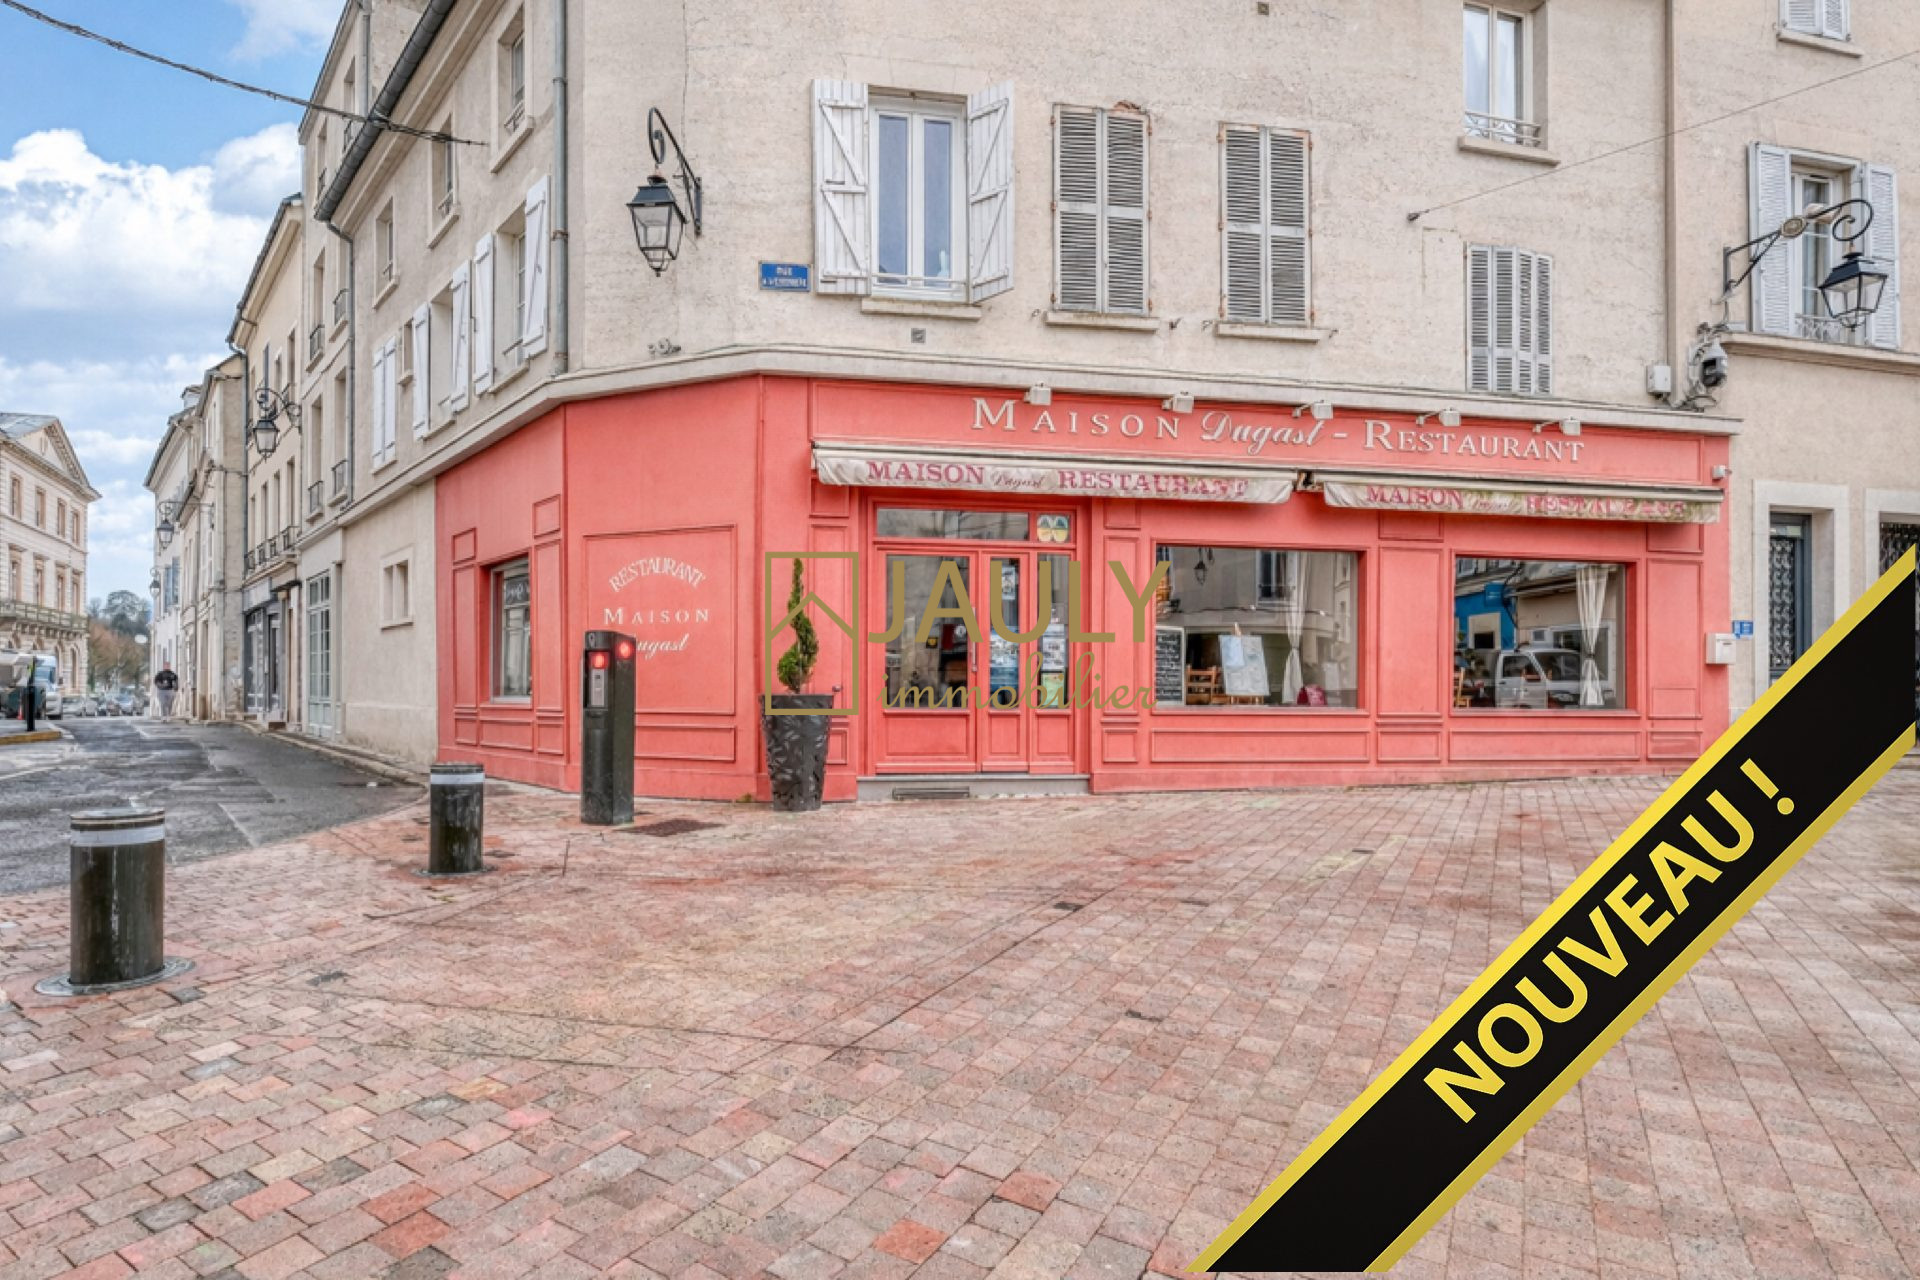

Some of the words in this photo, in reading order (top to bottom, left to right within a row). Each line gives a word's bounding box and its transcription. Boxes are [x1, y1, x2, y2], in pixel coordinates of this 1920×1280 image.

[972, 397, 1180, 438] MAISON
[1363, 419, 1585, 462] RESTAURANT
[867, 461, 985, 484] MAISON
[1366, 485, 1464, 510] MAISON
[609, 557, 706, 592] RESTAURANT
[604, 607, 708, 625] MAISON
[634, 633, 689, 660] ugast
